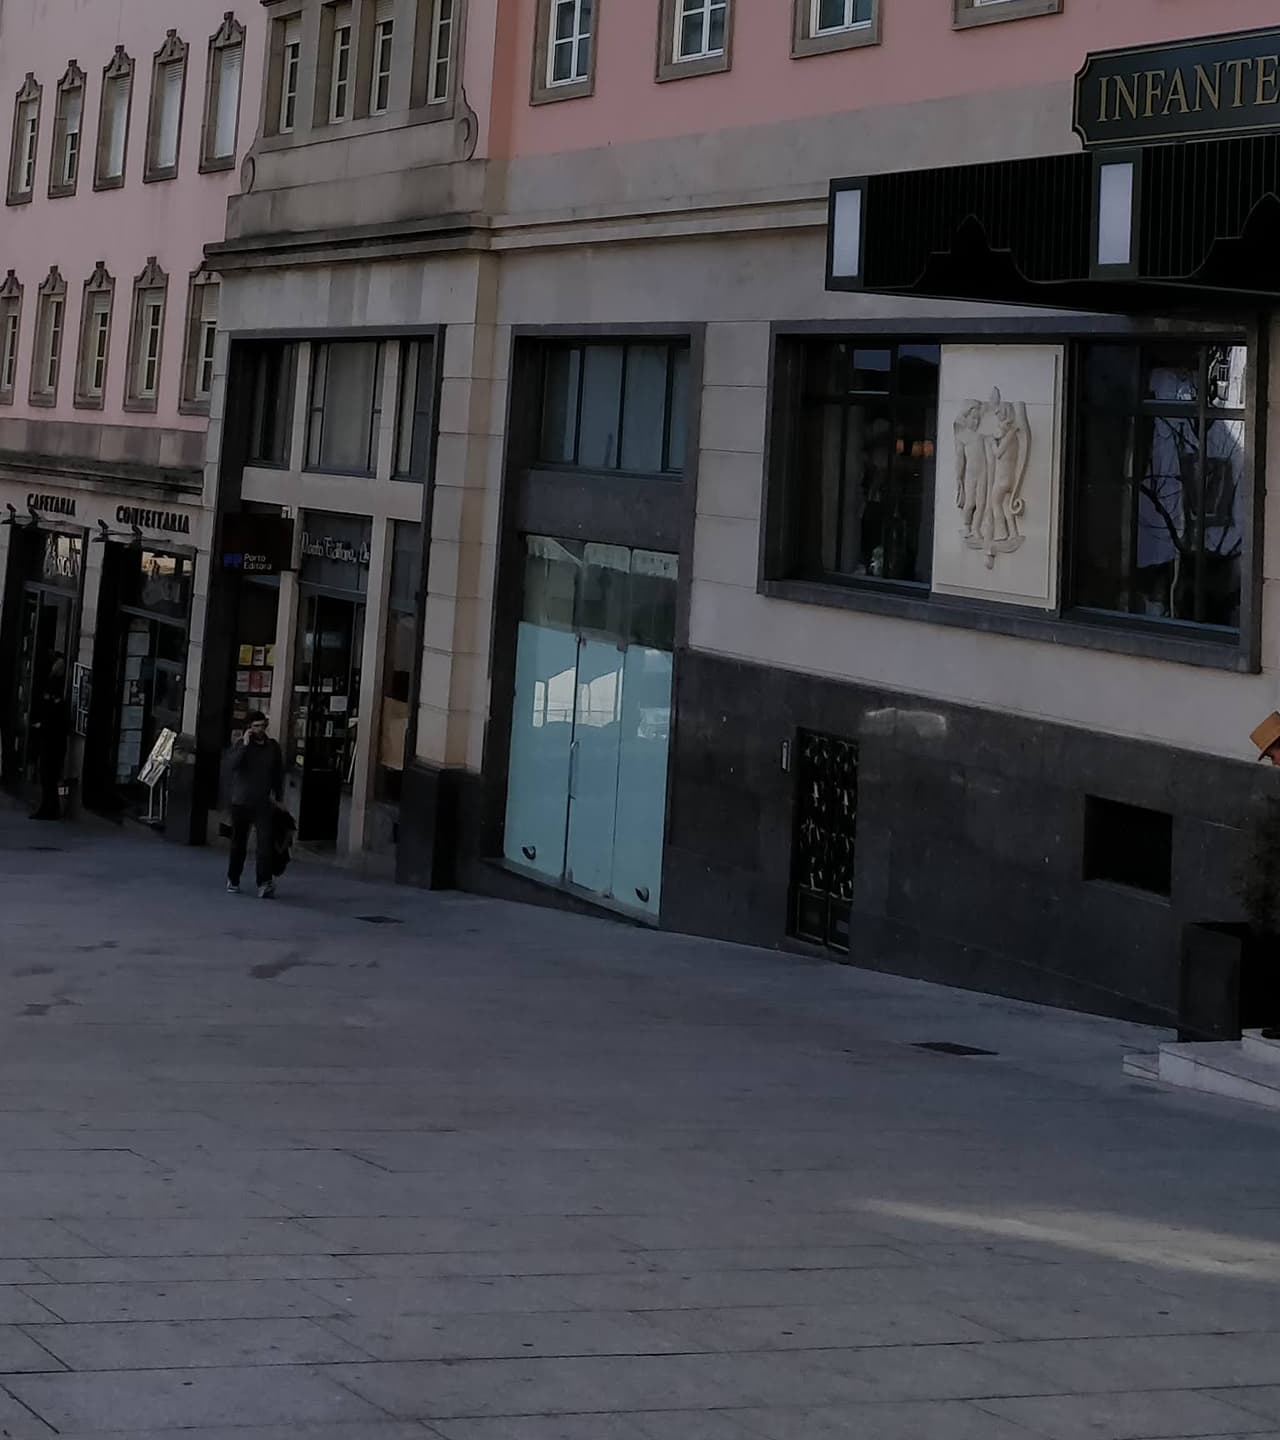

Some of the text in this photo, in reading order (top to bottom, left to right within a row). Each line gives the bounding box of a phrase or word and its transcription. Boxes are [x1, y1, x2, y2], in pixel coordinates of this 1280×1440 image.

[1096, 55, 1280, 122] INFANTE
[27, 493, 76, 516] CAFETARIA
[116, 505, 190, 534] CONFEITARIA
[243, 553, 267, 562] Porto
[243, 561, 272, 570] Editora
